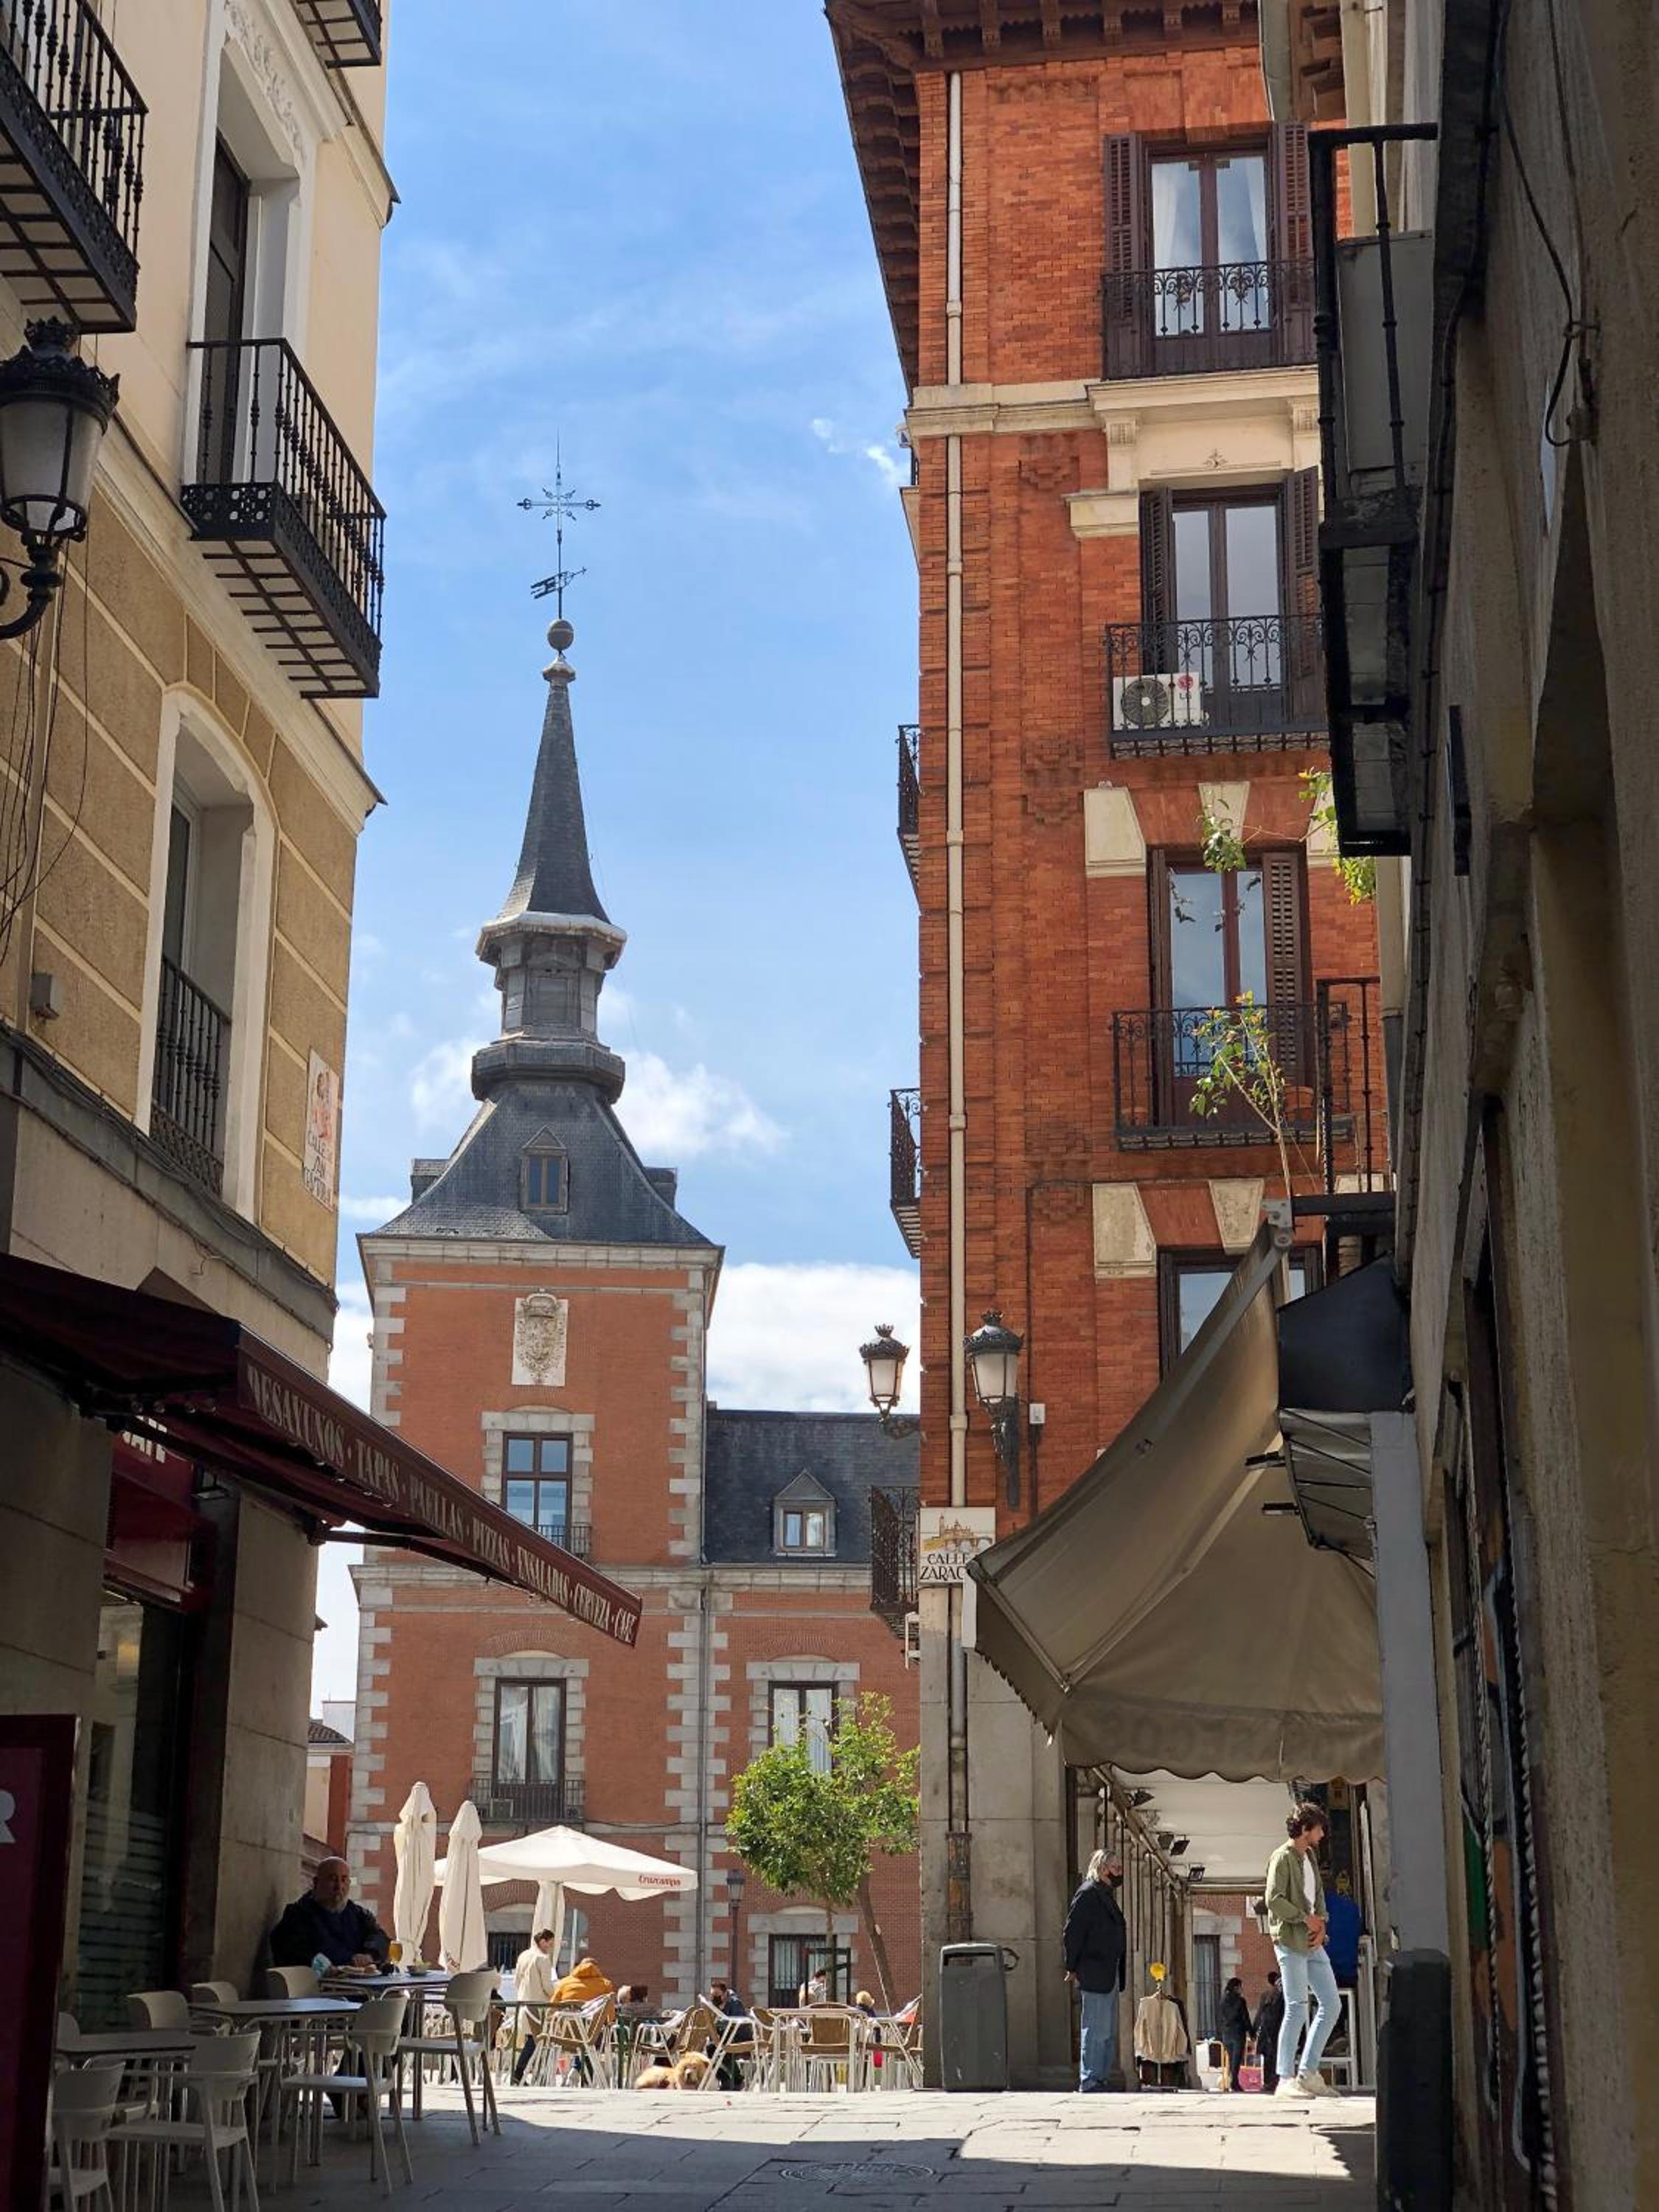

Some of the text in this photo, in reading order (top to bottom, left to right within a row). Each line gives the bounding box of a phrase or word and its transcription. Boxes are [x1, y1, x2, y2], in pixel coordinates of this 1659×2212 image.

[355, 1439, 400, 1502] TAPAS
[410, 1475, 464, 1544] PAELLAS
[473, 1517, 509, 1573] PIZZAS
[518, 1545, 570, 1607] ENSALADAS
